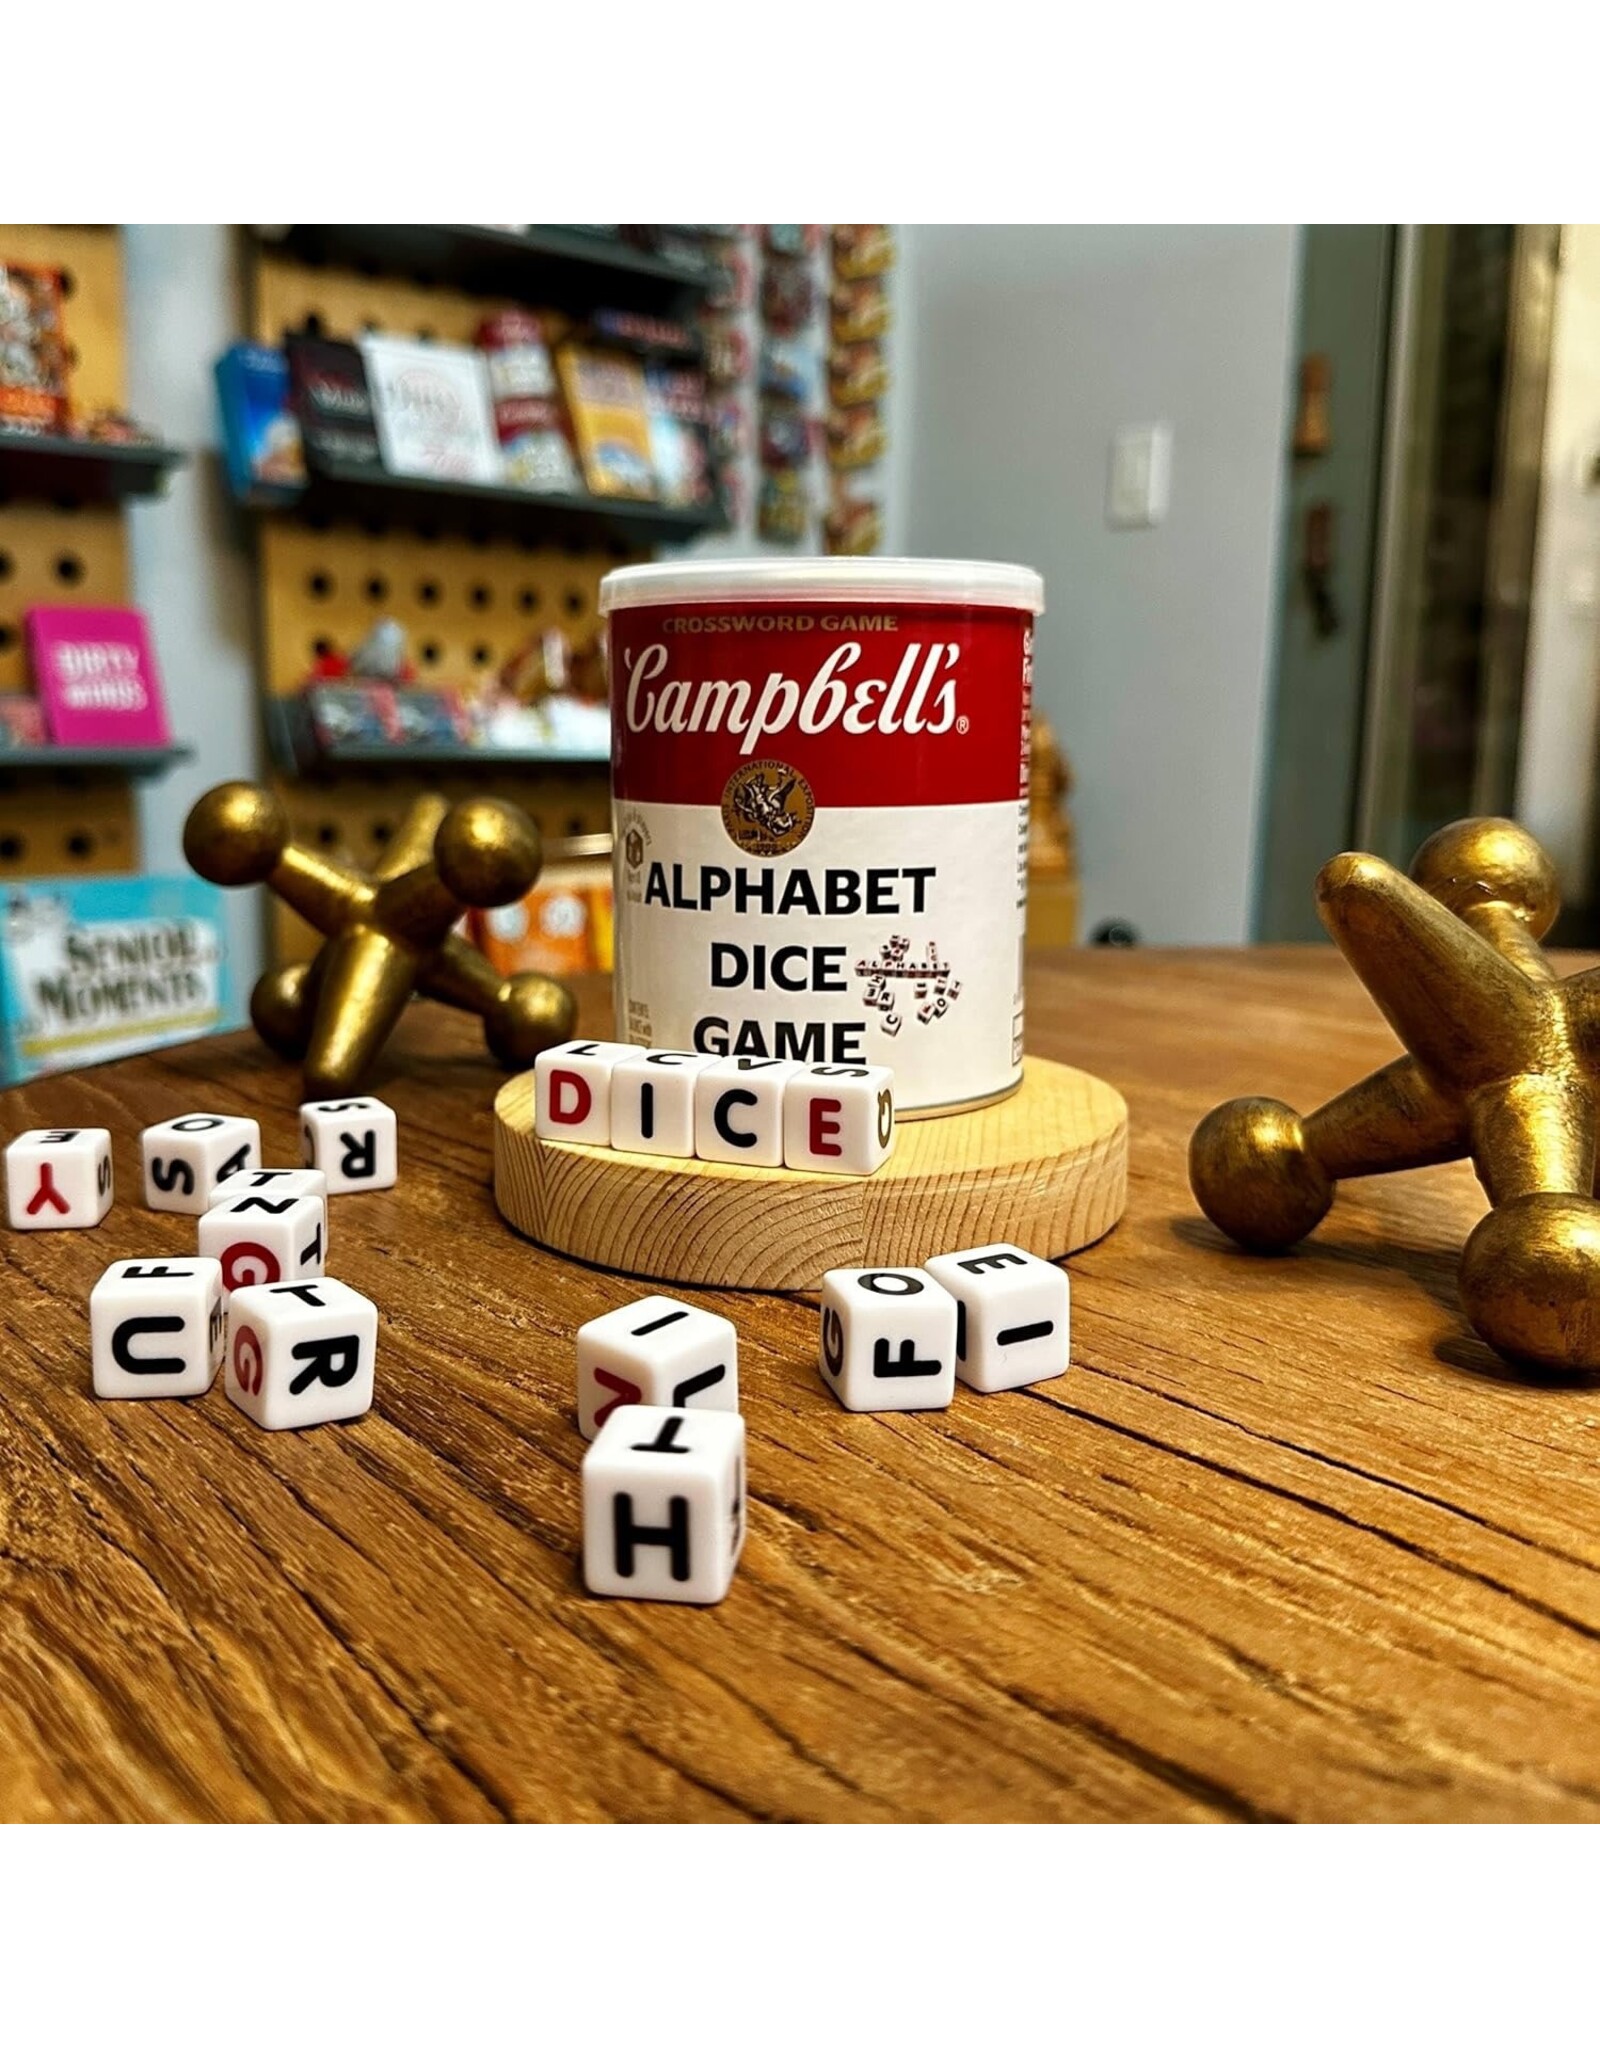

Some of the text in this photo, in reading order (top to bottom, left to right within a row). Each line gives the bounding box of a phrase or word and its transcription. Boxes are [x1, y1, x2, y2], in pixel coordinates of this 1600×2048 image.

[662, 615, 899, 634] CROSSWORD GAME
[624, 641, 960, 755] Campbell's
[725, 761, 796, 799] INTERNATIONAL
[645, 861, 936, 915] ALPHABET
[711, 942, 847, 992] DICE
[645, 1053, 700, 1065] C
[693, 1016, 867, 1065] GAME
[810, 1066, 869, 1078] S
[341, 1129, 376, 1178] R
[26, 1162, 70, 1215] Y
[151, 1157, 195, 1195] S
[250, 1172, 293, 1187] T
[121, 1266, 195, 1279] F
[220, 1242, 281, 1292] G
[957, 1253, 1028, 1274] E
[269, 1284, 326, 1307] T
[857, 1273, 924, 1295] O
[112, 1316, 186, 1374] U
[823, 1307, 844, 1376] G
[997, 1320, 1054, 1346] I
[233, 1325, 263, 1396] G
[289, 1335, 359, 1395] R
[874, 1338, 943, 1378] F
[629, 1416, 691, 1454] T
[613, 1492, 690, 1582] H
